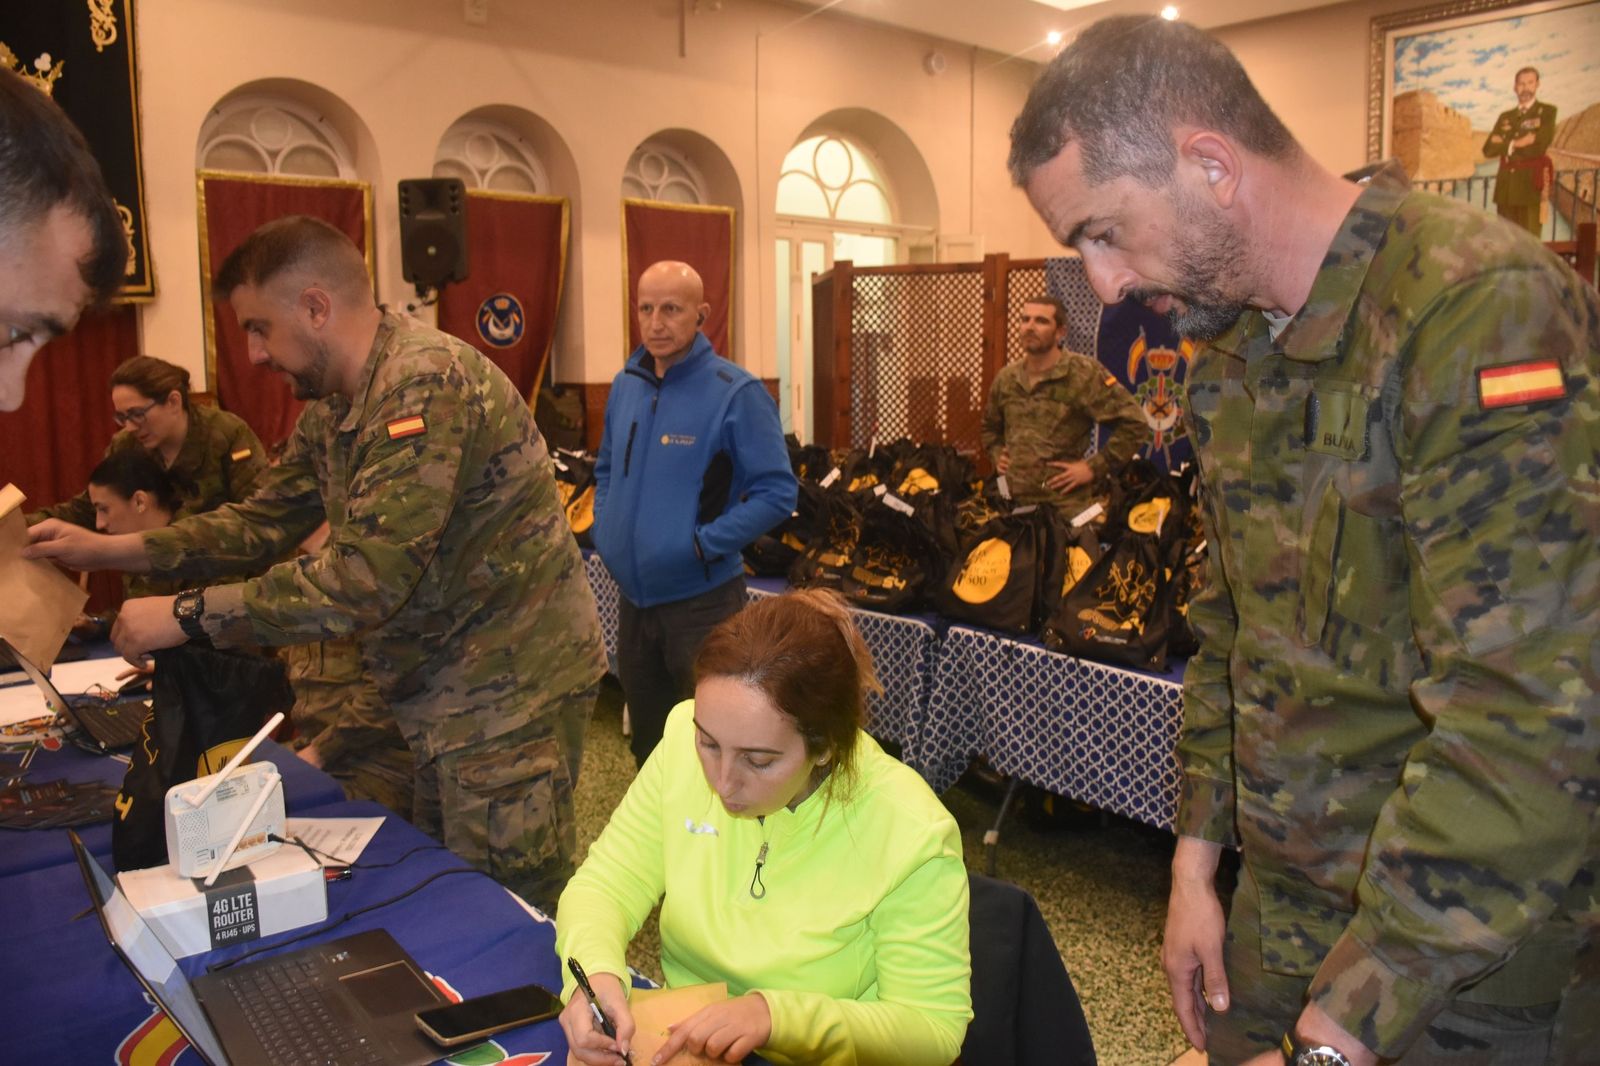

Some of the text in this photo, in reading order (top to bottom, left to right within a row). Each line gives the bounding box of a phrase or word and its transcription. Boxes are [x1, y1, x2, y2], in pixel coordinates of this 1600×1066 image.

[213, 893, 252, 914] 4G LTE
[213, 908, 254, 928] ROUTER
[216, 924, 255, 941] 4 RJ45 UPS
